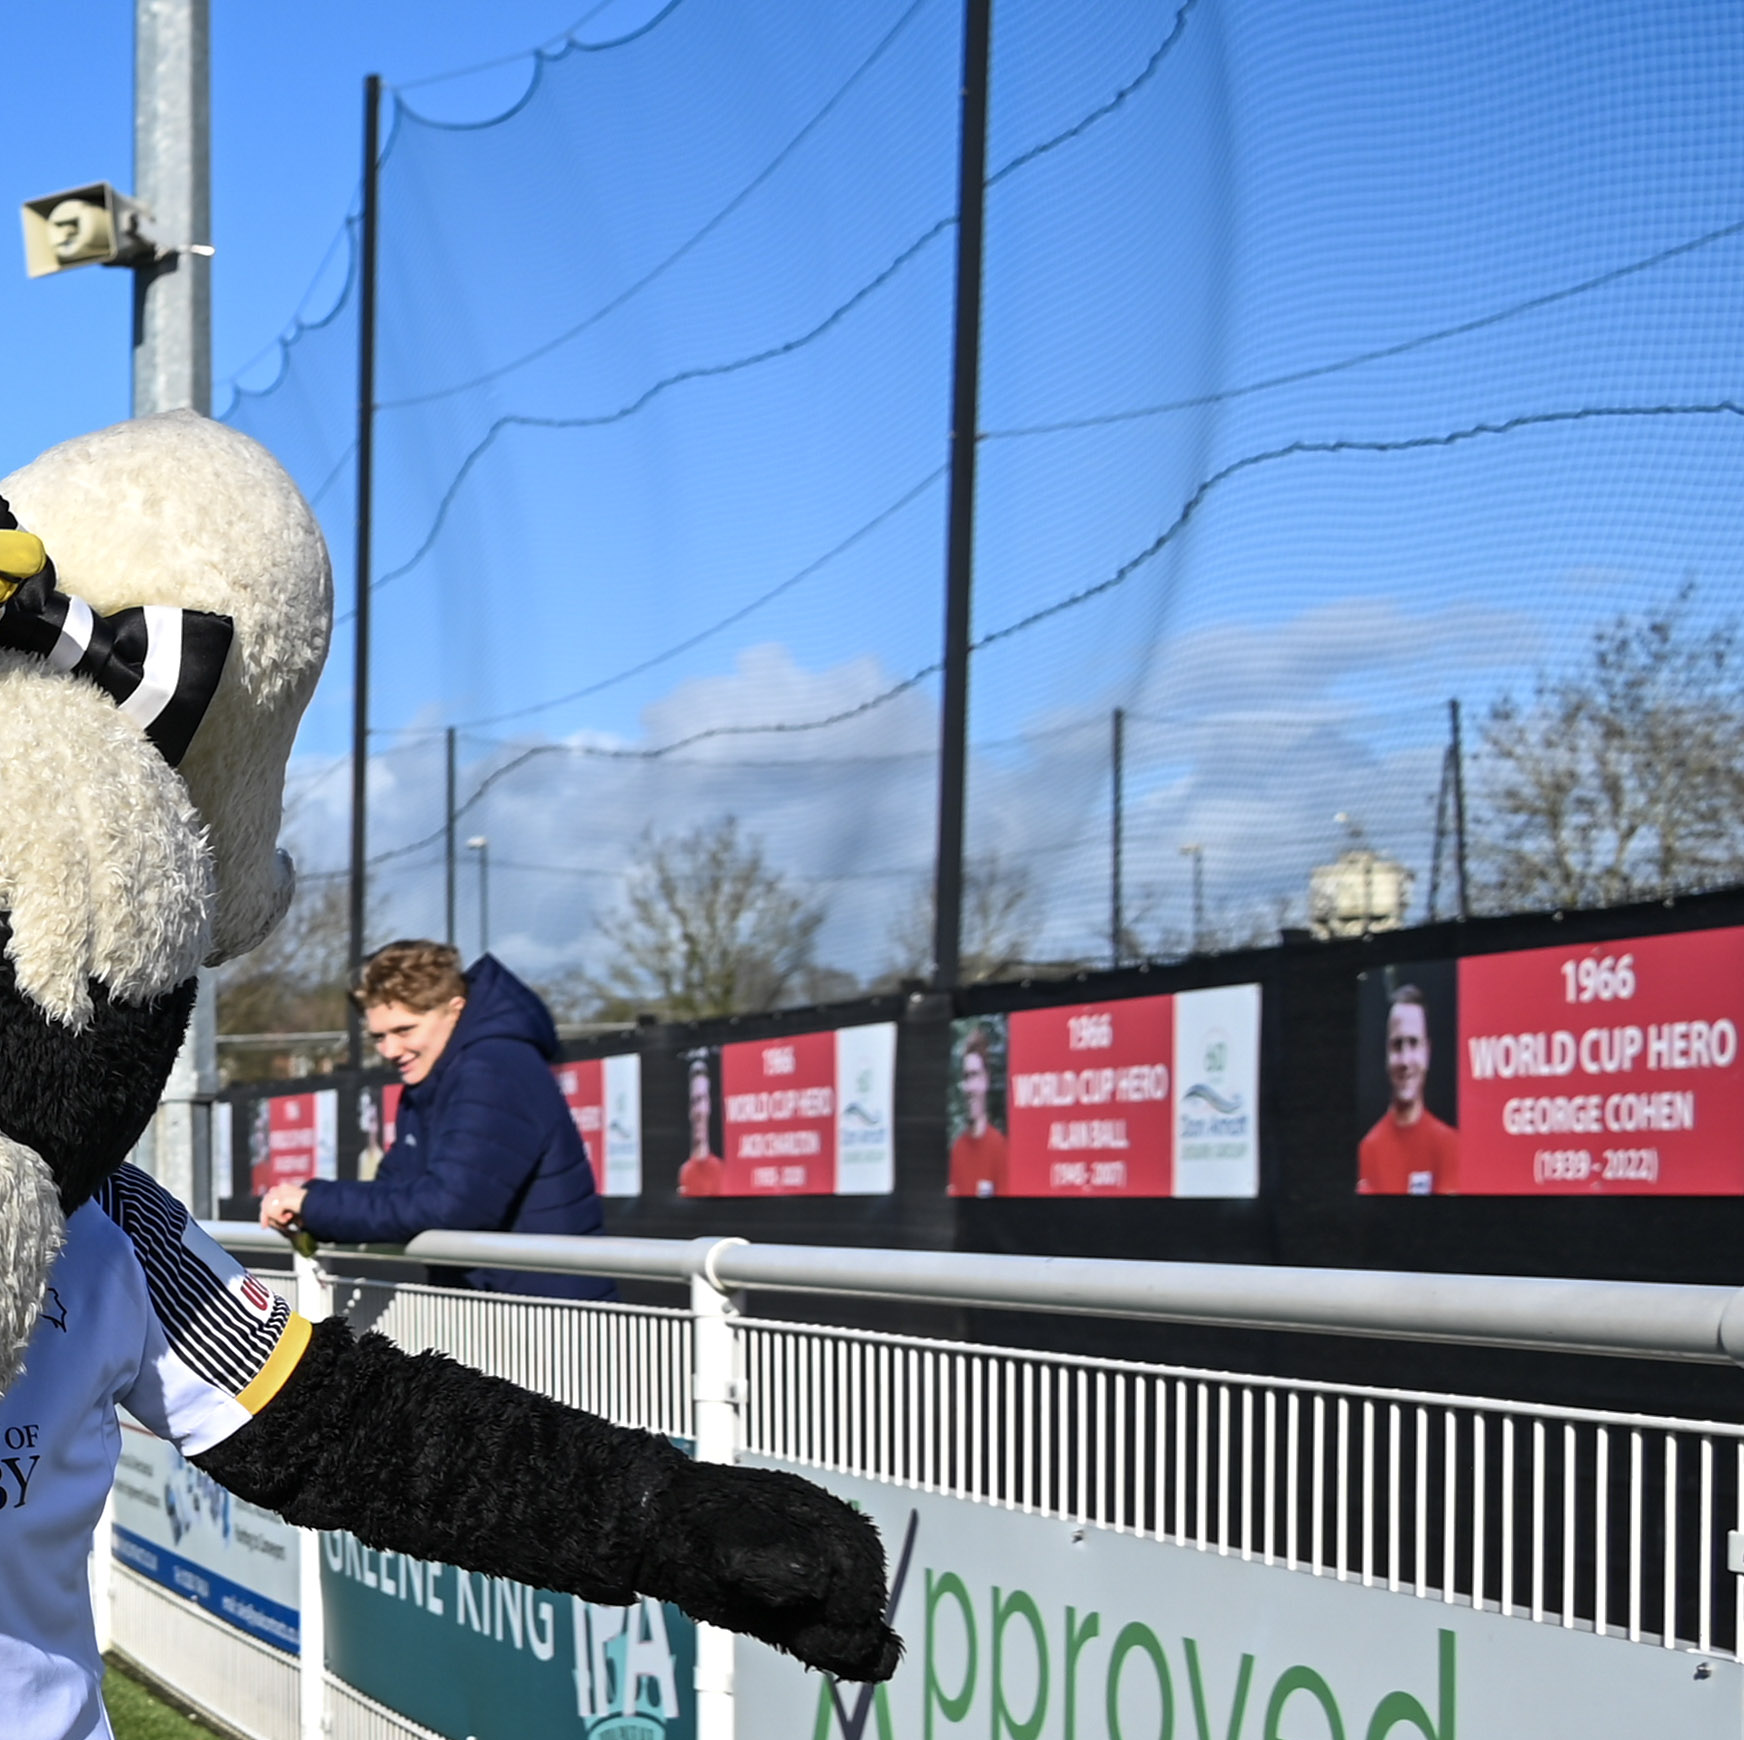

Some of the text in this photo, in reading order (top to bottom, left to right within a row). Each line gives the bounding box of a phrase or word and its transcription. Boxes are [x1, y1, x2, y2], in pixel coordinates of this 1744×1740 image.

[1560, 953, 1637, 1003] 1966
[1067, 1012, 1114, 1051] 1966
[1468, 1017, 1738, 1079] WORLD CUP HERO
[1012, 1062, 1170, 1108] WORLD CUP HERO
[1502, 1091, 1695, 1135] GEORGE COHEN
[1533, 1149, 1593, 1185] (1939
[1602, 1147, 1660, 1183] 2022)
[4, 1424, 40, 1450] OF
